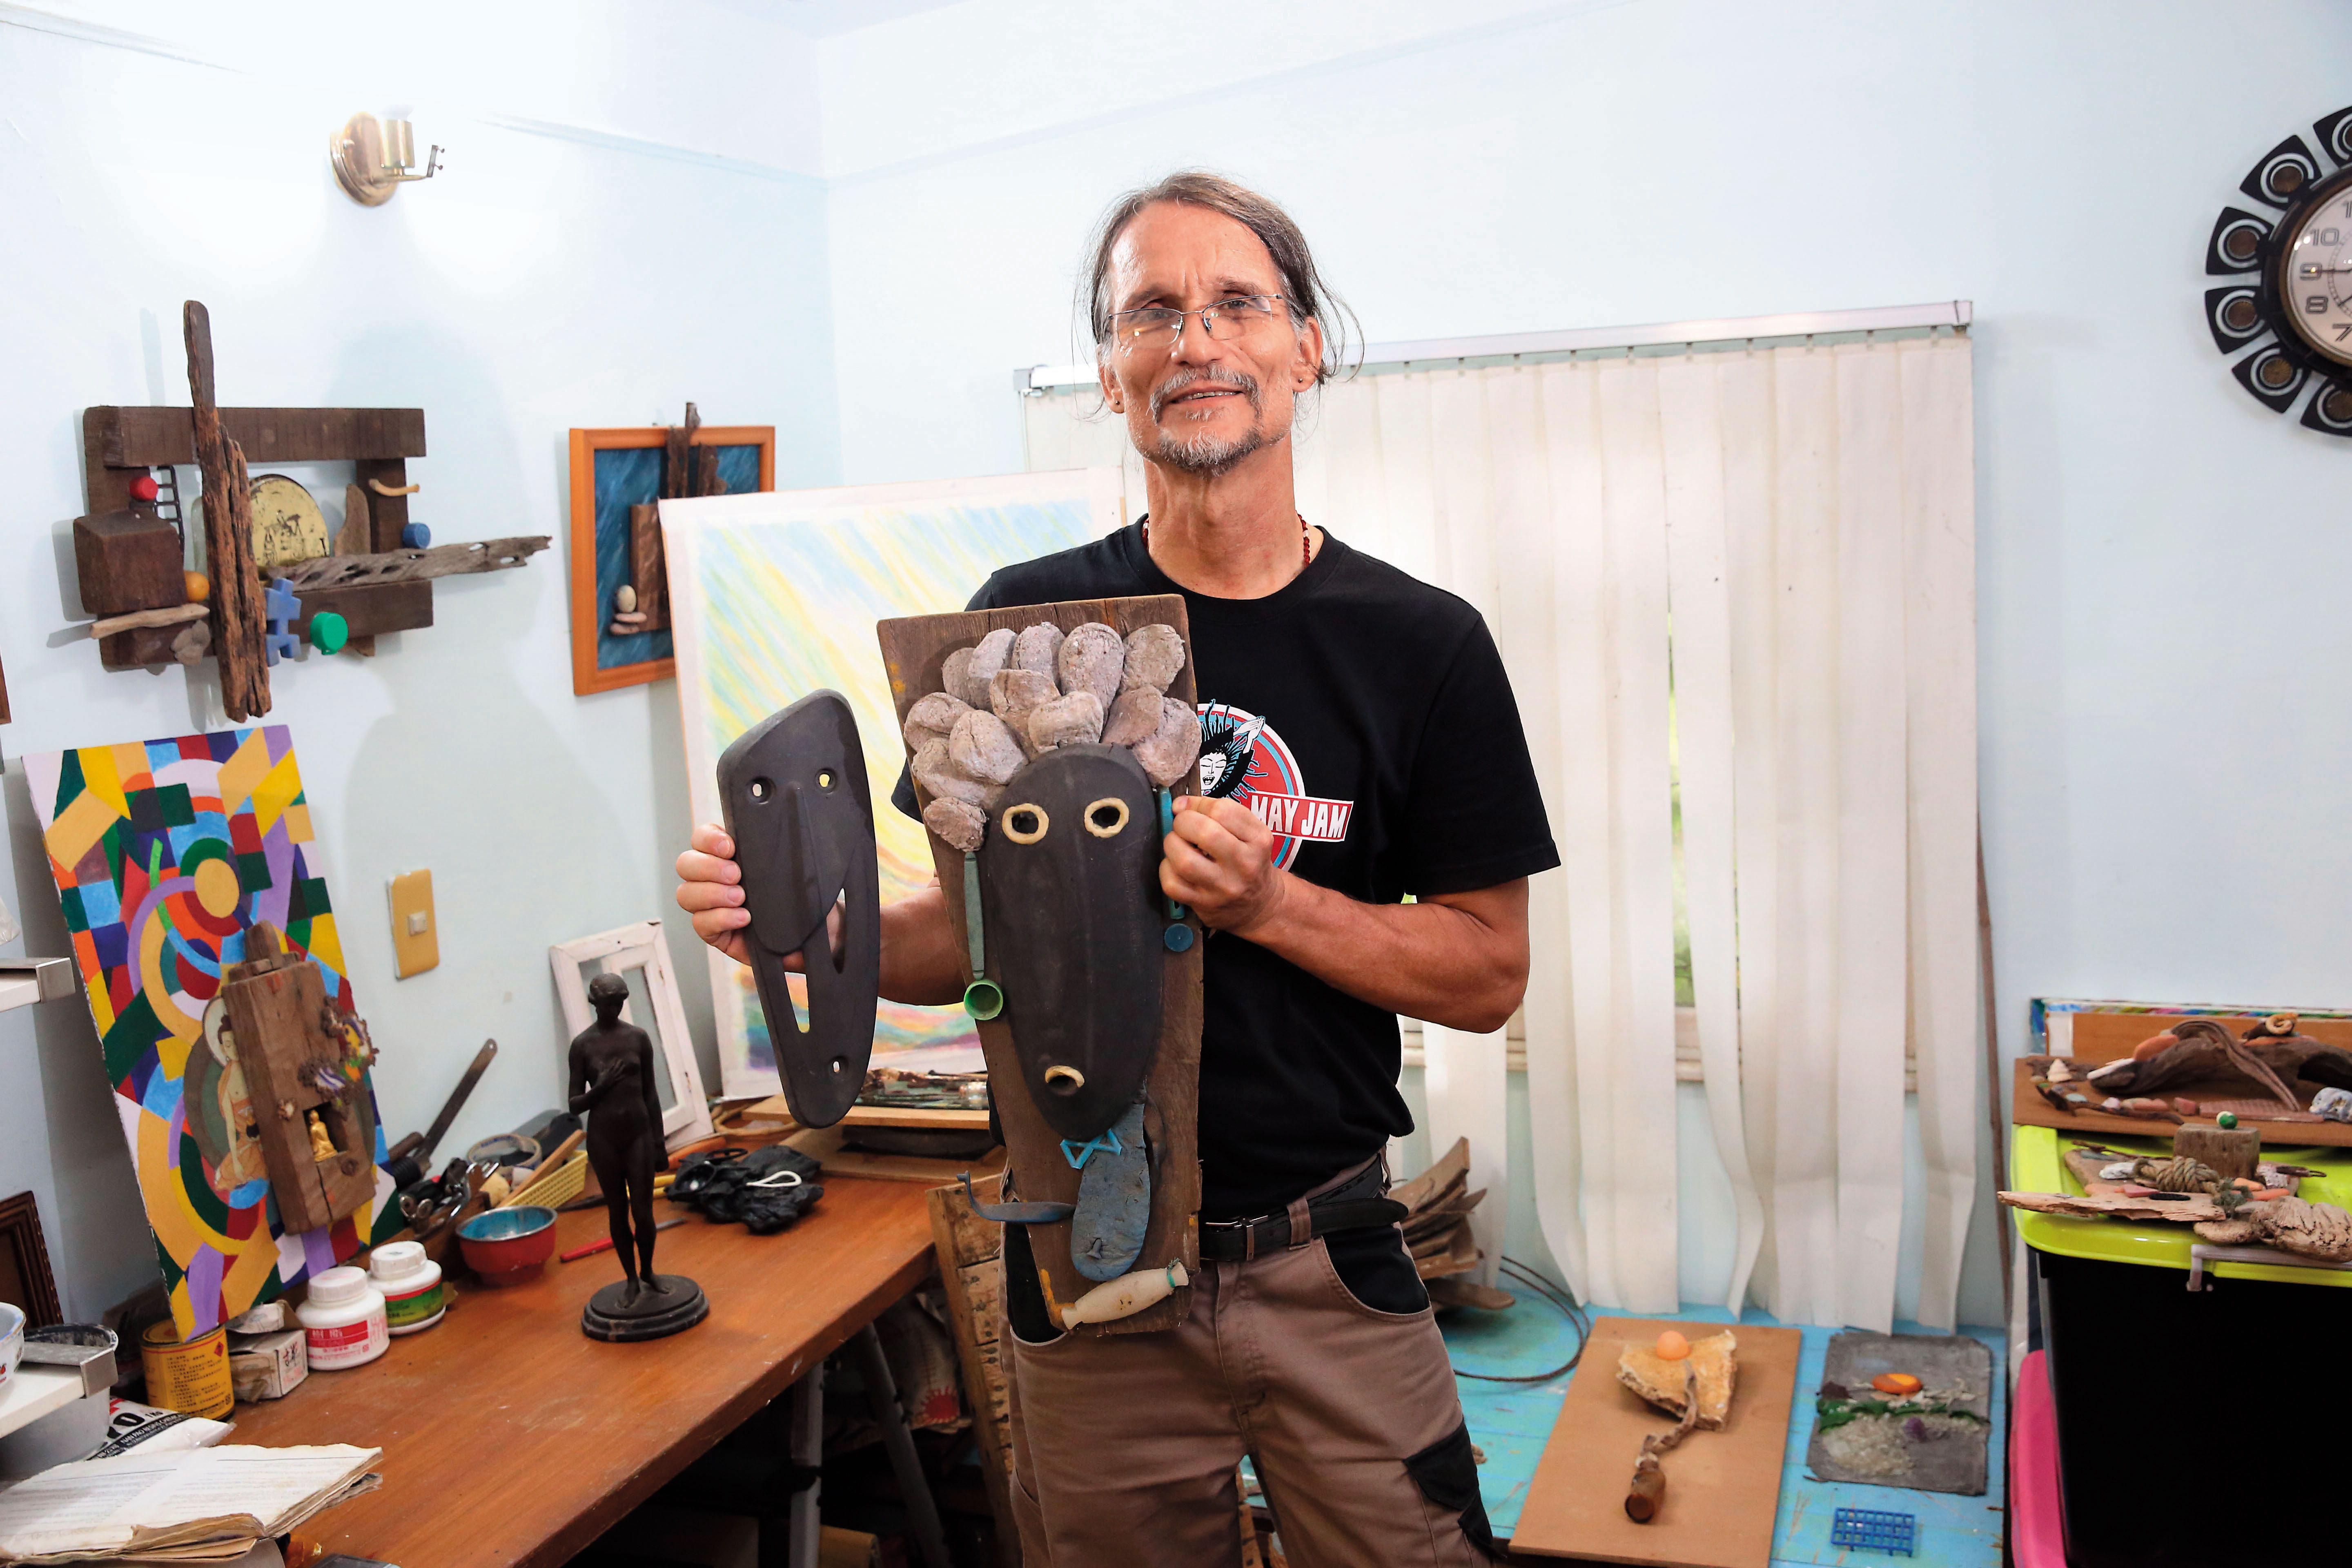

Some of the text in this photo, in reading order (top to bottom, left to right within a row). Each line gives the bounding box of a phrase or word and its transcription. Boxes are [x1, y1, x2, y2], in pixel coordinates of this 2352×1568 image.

[2310, 227, 2339, 246] 10
[2300, 262, 2322, 281] 9
[2305, 295, 2328, 314] 8
[2332, 323, 2352, 342] 7
[1250, 795, 1348, 838] MAY JAM
